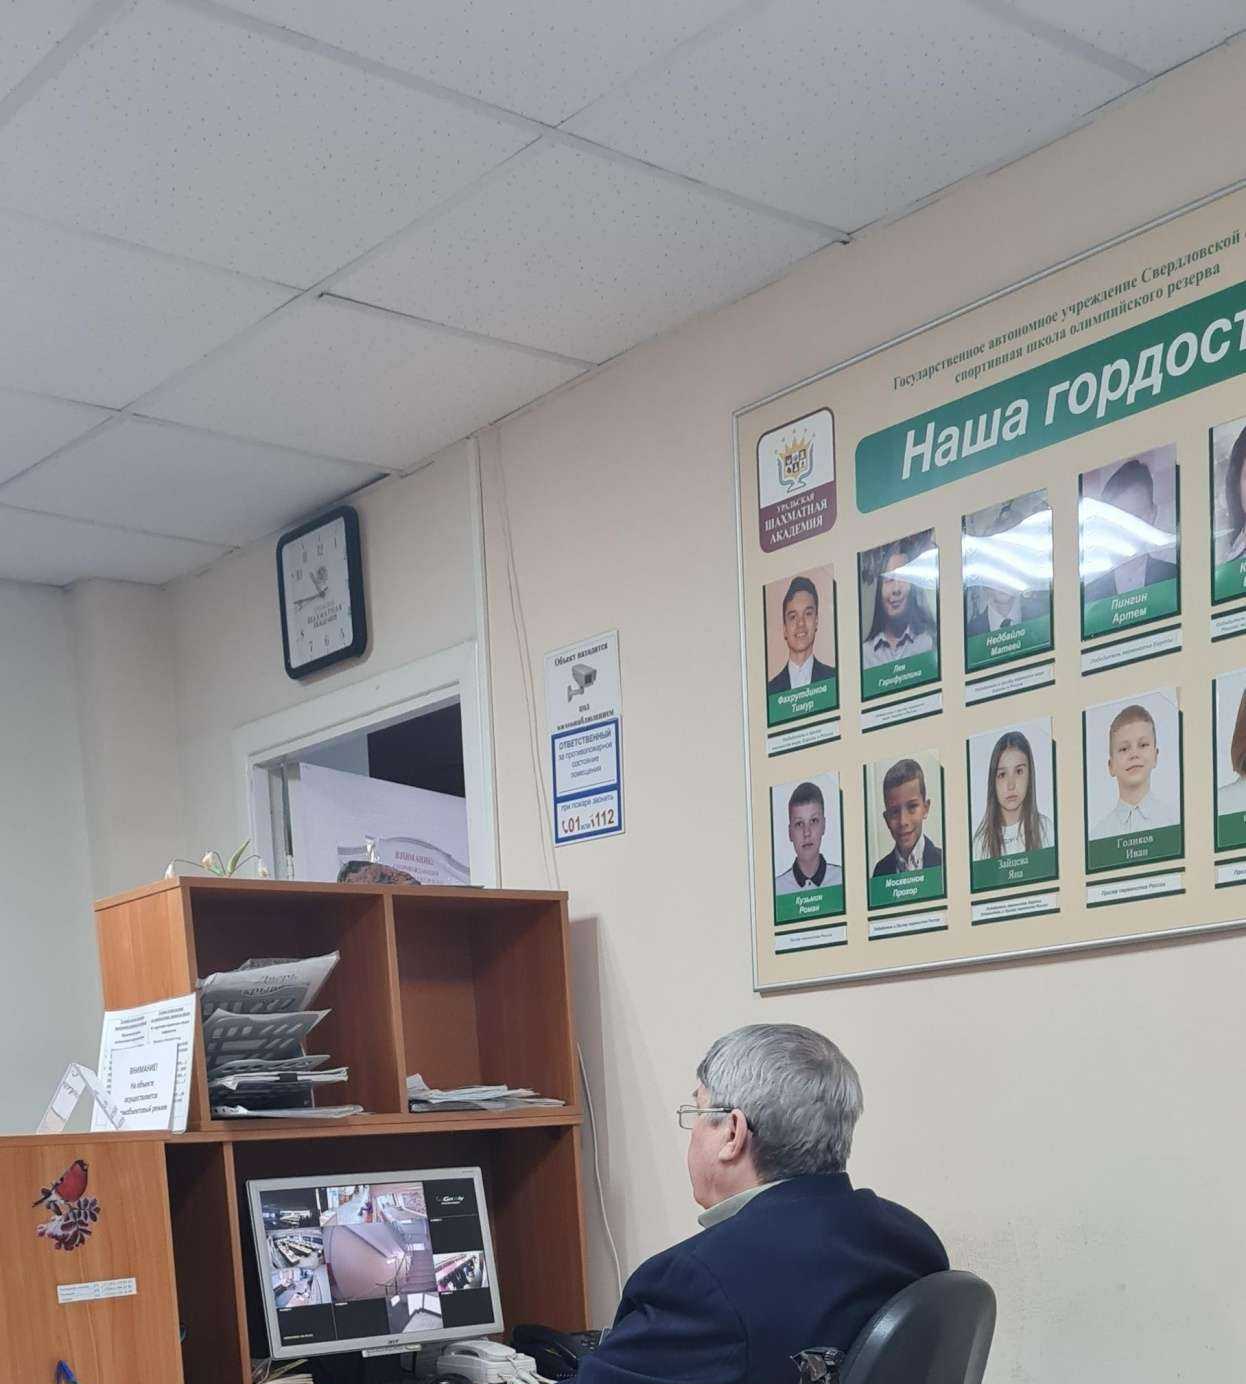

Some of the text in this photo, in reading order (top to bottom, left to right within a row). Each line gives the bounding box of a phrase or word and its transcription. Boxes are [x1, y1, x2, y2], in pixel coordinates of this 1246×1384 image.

[893, 229, 1241, 390] Государственное автономное учреждение Свердловской
[955, 263, 1221, 384] спортивная школа олимпийского резерва
[902, 398, 1029, 480] Наша
[764, 498, 828, 532] ШАХМАТНАЯ
[769, 515, 823, 544] АКАДЕМИЯ
[559, 728, 612, 750] ОТВЕТСТВЕННЫЙ
[568, 816, 580, 833] 01
[596, 809, 615, 827] 112
